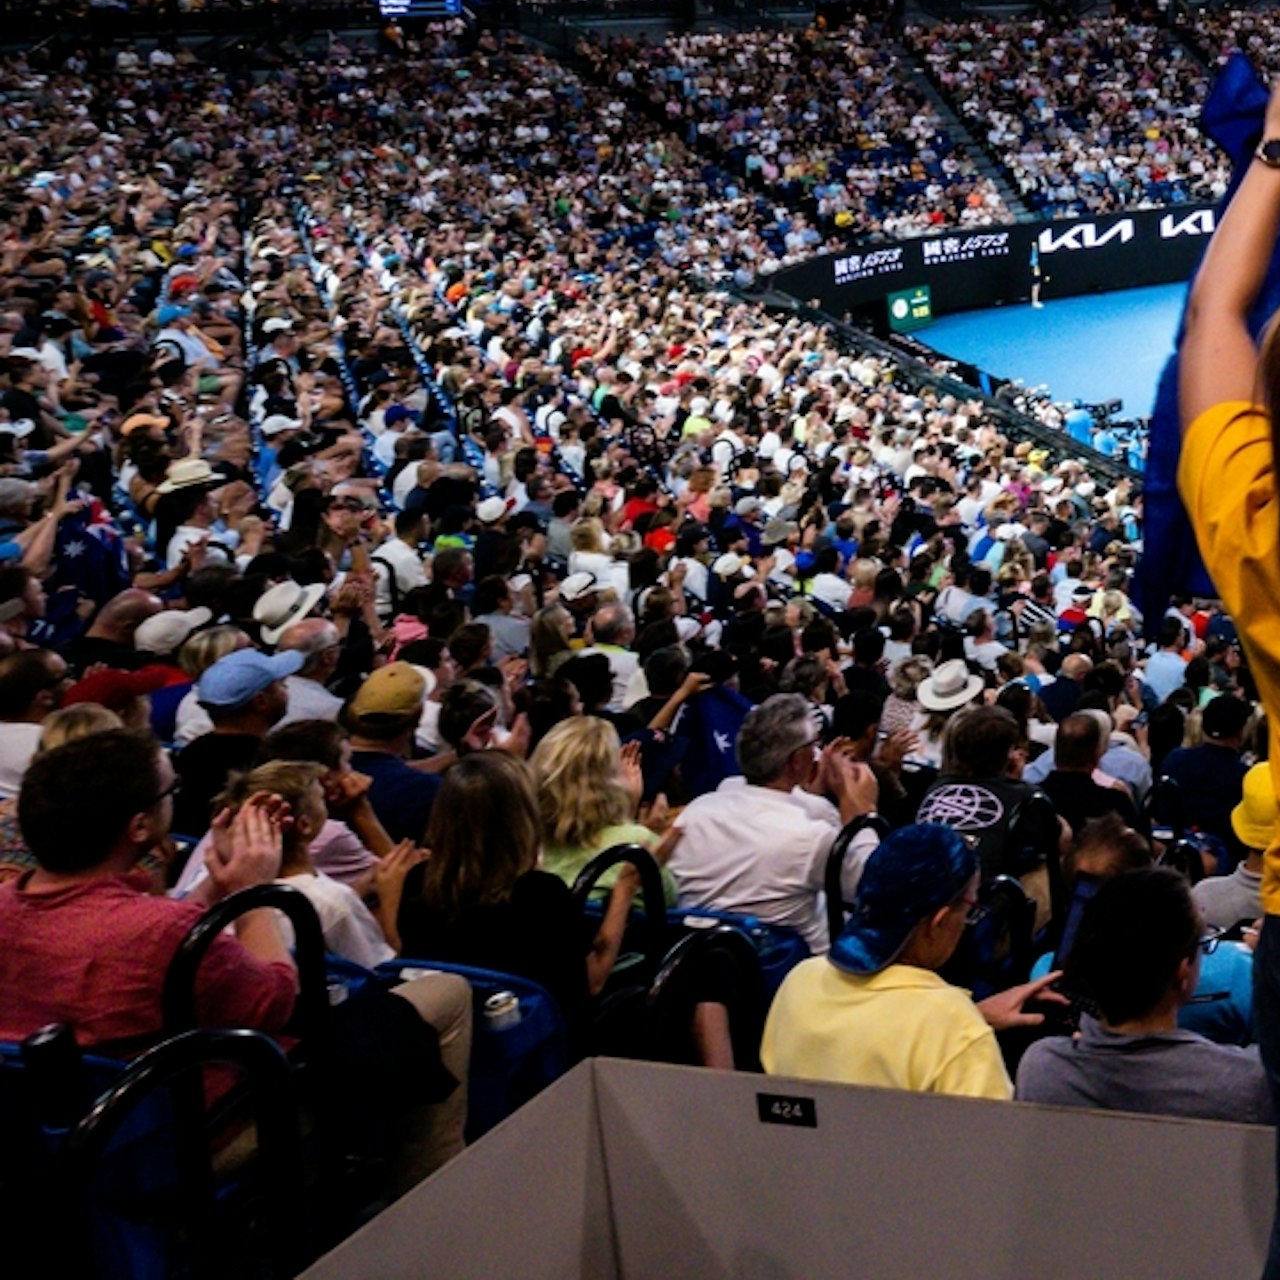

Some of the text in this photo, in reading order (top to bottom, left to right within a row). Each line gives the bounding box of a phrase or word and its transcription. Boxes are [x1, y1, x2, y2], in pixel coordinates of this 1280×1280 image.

[1038, 219, 1134, 254] KIA
[1159, 209, 1215, 238] KI
[770, 1100, 803, 1119] 424
